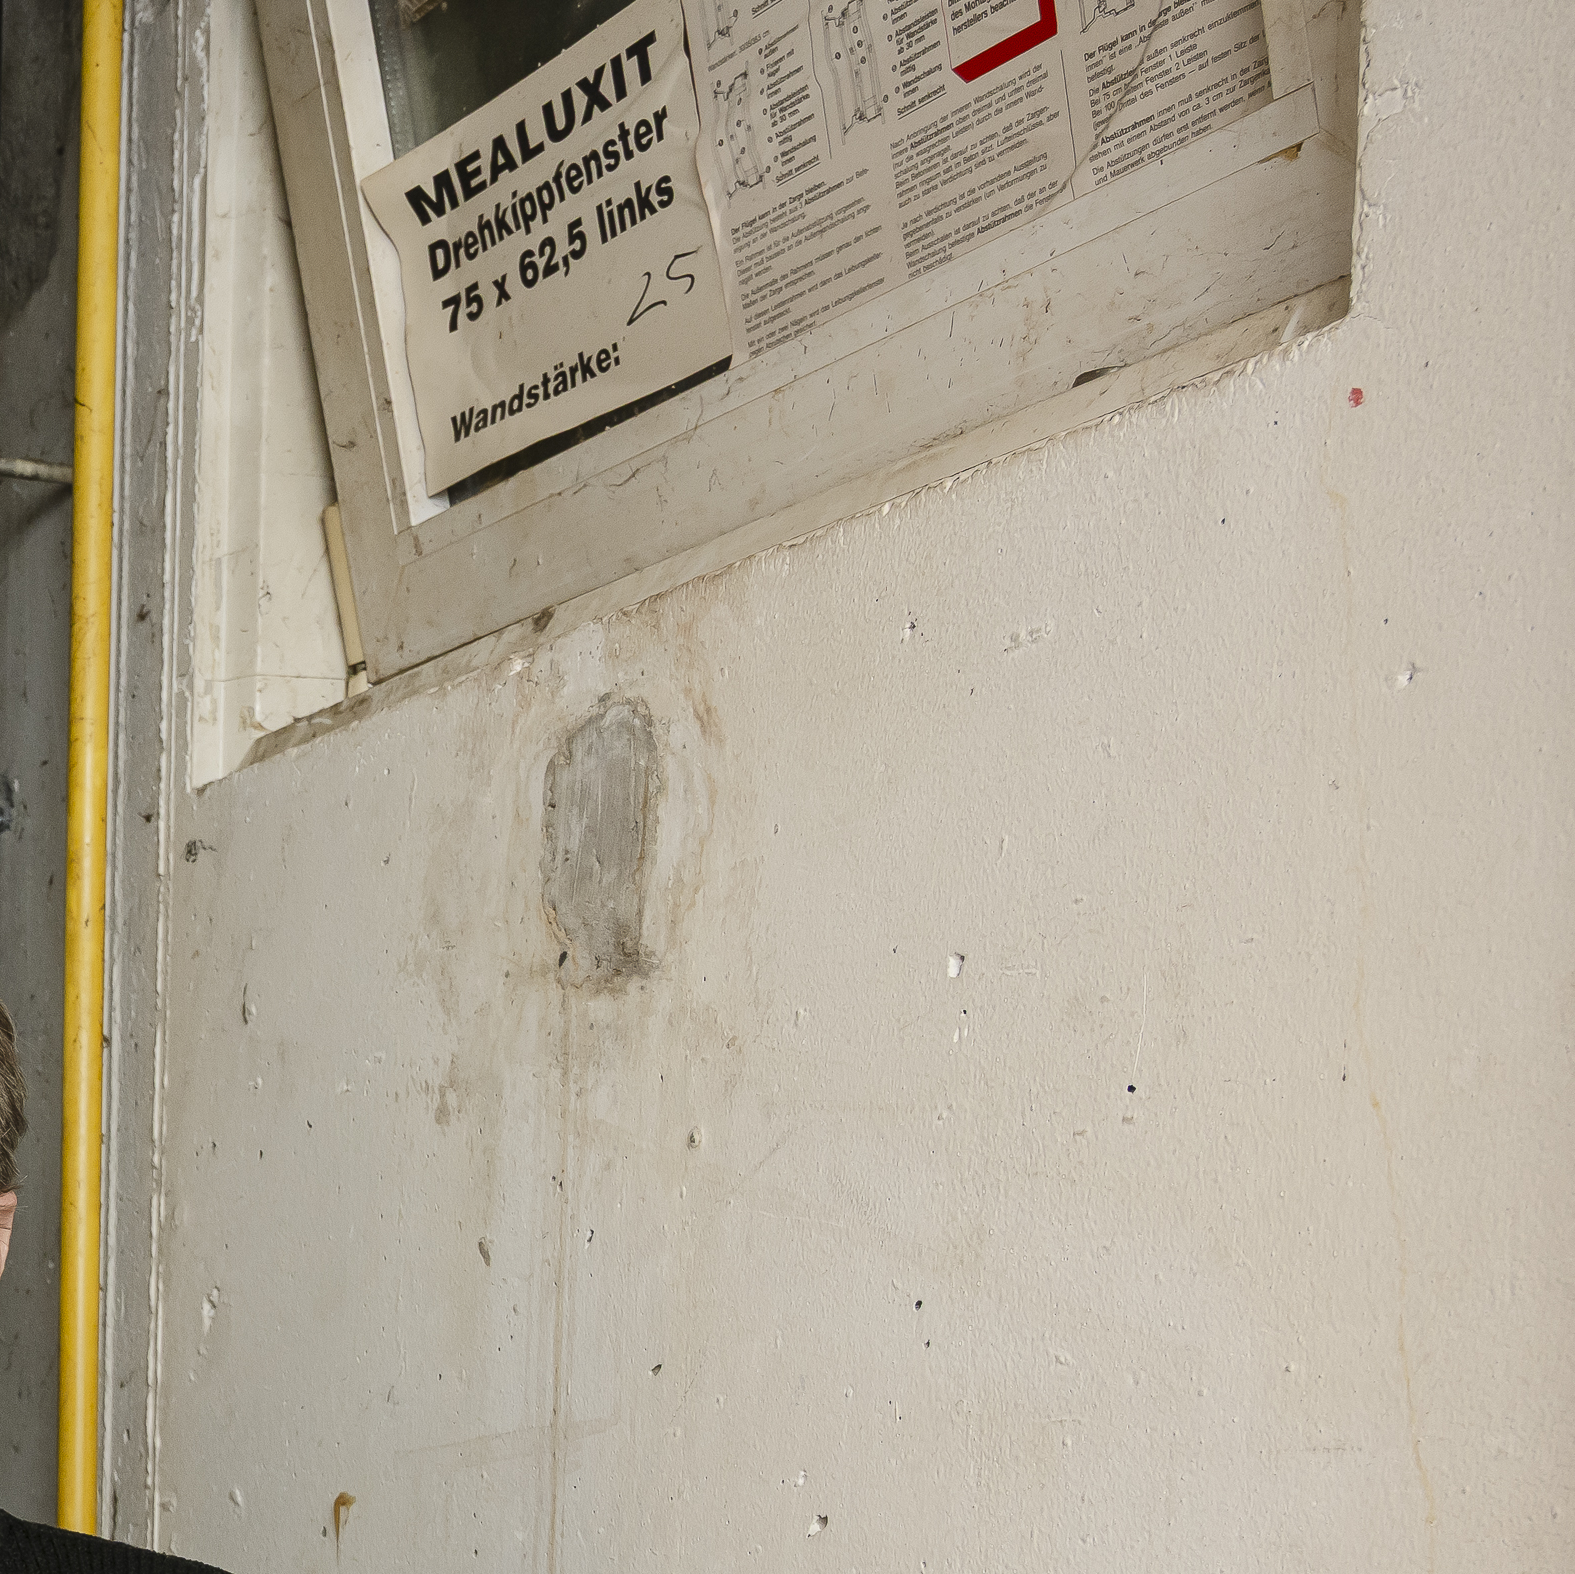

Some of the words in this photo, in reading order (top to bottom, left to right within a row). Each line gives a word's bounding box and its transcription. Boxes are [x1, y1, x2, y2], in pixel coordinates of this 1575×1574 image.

[1084, 50, 1095, 61] Der
[1098, 36, 1118, 54] Flügel
[1120, 28, 1136, 41] kann
[1139, 23, 1145, 32] in
[1140, 58, 1165, 76] Fenster
[1175, 42, 1196, 58] Leiste
[1146, 46, 1167, 61] außen
[1170, 25, 1204, 49] senkrecht
[973, 78, 1016, 105] Wandschalung
[1032, 64, 1042, 73] der
[1139, 87, 1153, 99] des
[1155, 71, 1186, 91] Fensters
[1198, 58, 1208, 70] auf
[1211, 48, 1231, 63] festen
[1233, 40, 1246, 52] Sitz
[1145, 67, 1171, 85] Fenster
[1175, 61, 1179, 70] 2
[1182, 49, 1207, 66] Leisten
[1089, 86, 1099, 96] Die
[1100, 113, 1154, 145] Abstützrahmen
[1156, 103, 1175, 117] innen
[1177, 93, 1192, 107] muß
[1194, 75, 1228, 98] senkrecht
[1239, 66, 1250, 76] der
[1102, 90, 1110, 101] 75
[1112, 85, 1122, 96] cm
[404, 29, 657, 226] MEALUXIT
[909, 122, 953, 149] Abstützrahmen
[994, 93, 1005, 104] und
[1014, 117, 1024, 127] der
[1114, 138, 1124, 150] mit
[1126, 129, 1146, 144] einem
[1148, 113, 1175, 133] Abstand
[1177, 107, 1189, 119] von
[1204, 96, 1209, 105] 3
[1211, 91, 1222, 101] cm
[1225, 84, 1236, 94] zur
[1092, 164, 1104, 176] Die
[1106, 142, 1149, 168] Abstützungen
[1095, 172, 1106, 186] und
[1110, 154, 1144, 178] Mauerwerk
[427, 104, 668, 282] Drehkippfenster
[976, 209, 1021, 235] Abstützrahmen
[441, 281, 484, 334] 75
[491, 272, 511, 308] x
[518, 216, 587, 289] 62,5
[596, 174, 675, 245] links
[451, 342, 621, 444] Wandstärke:
